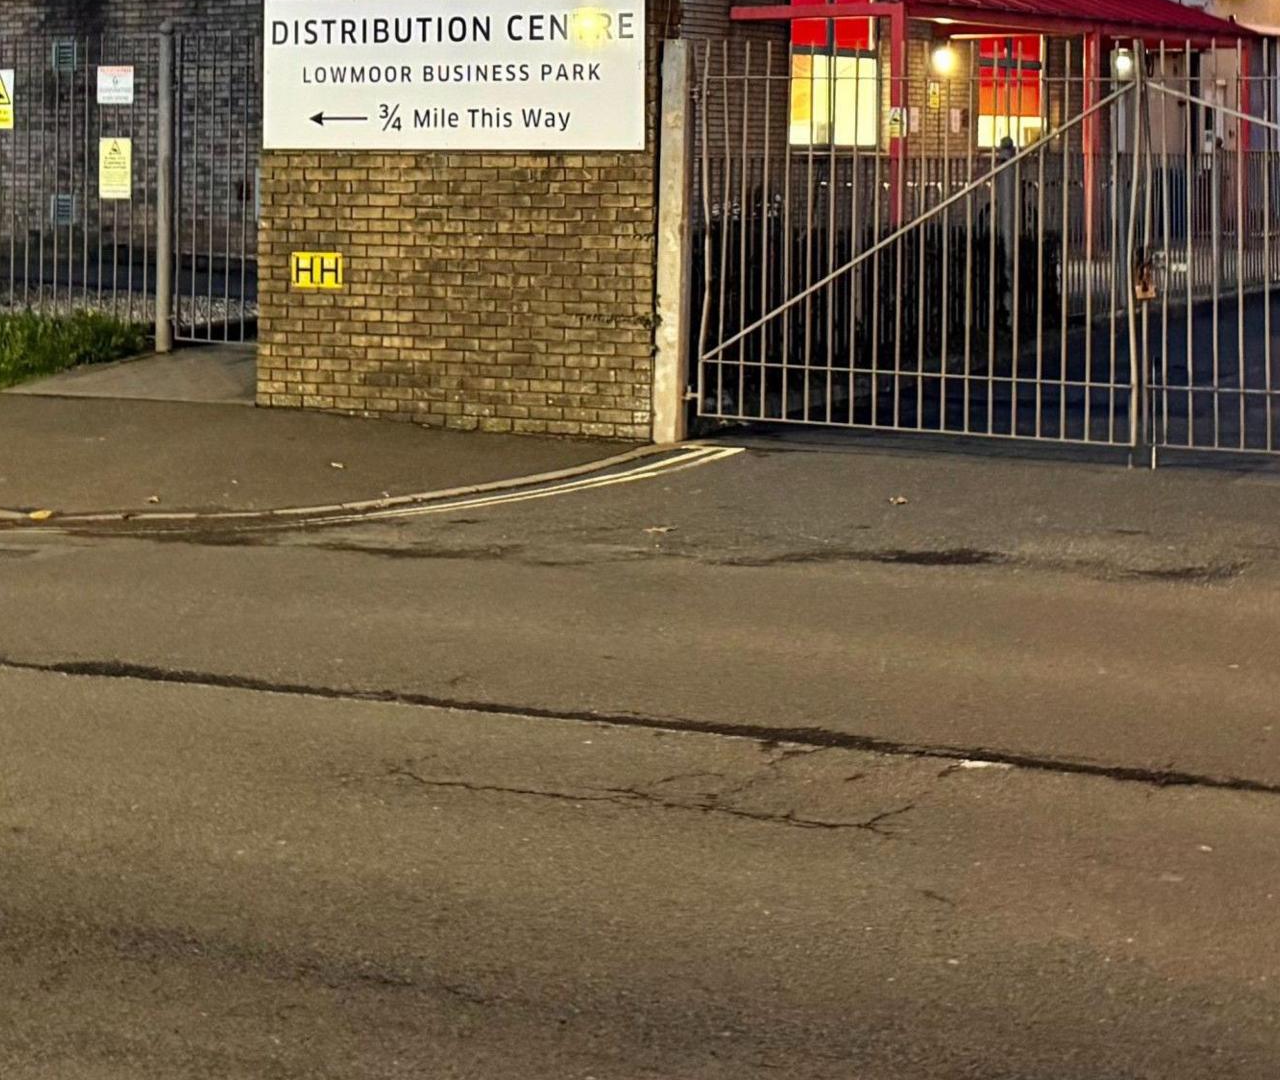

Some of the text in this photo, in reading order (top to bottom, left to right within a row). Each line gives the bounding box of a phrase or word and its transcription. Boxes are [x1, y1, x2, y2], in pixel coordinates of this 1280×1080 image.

[271, 13, 634, 45] DISTRIBUTION CENRE
[303, 63, 601, 83] LOWMOOR BUSINESS PARK
[413, 108, 459, 128] Mile
[468, 108, 512, 128] This
[522, 108, 570, 132] Way
